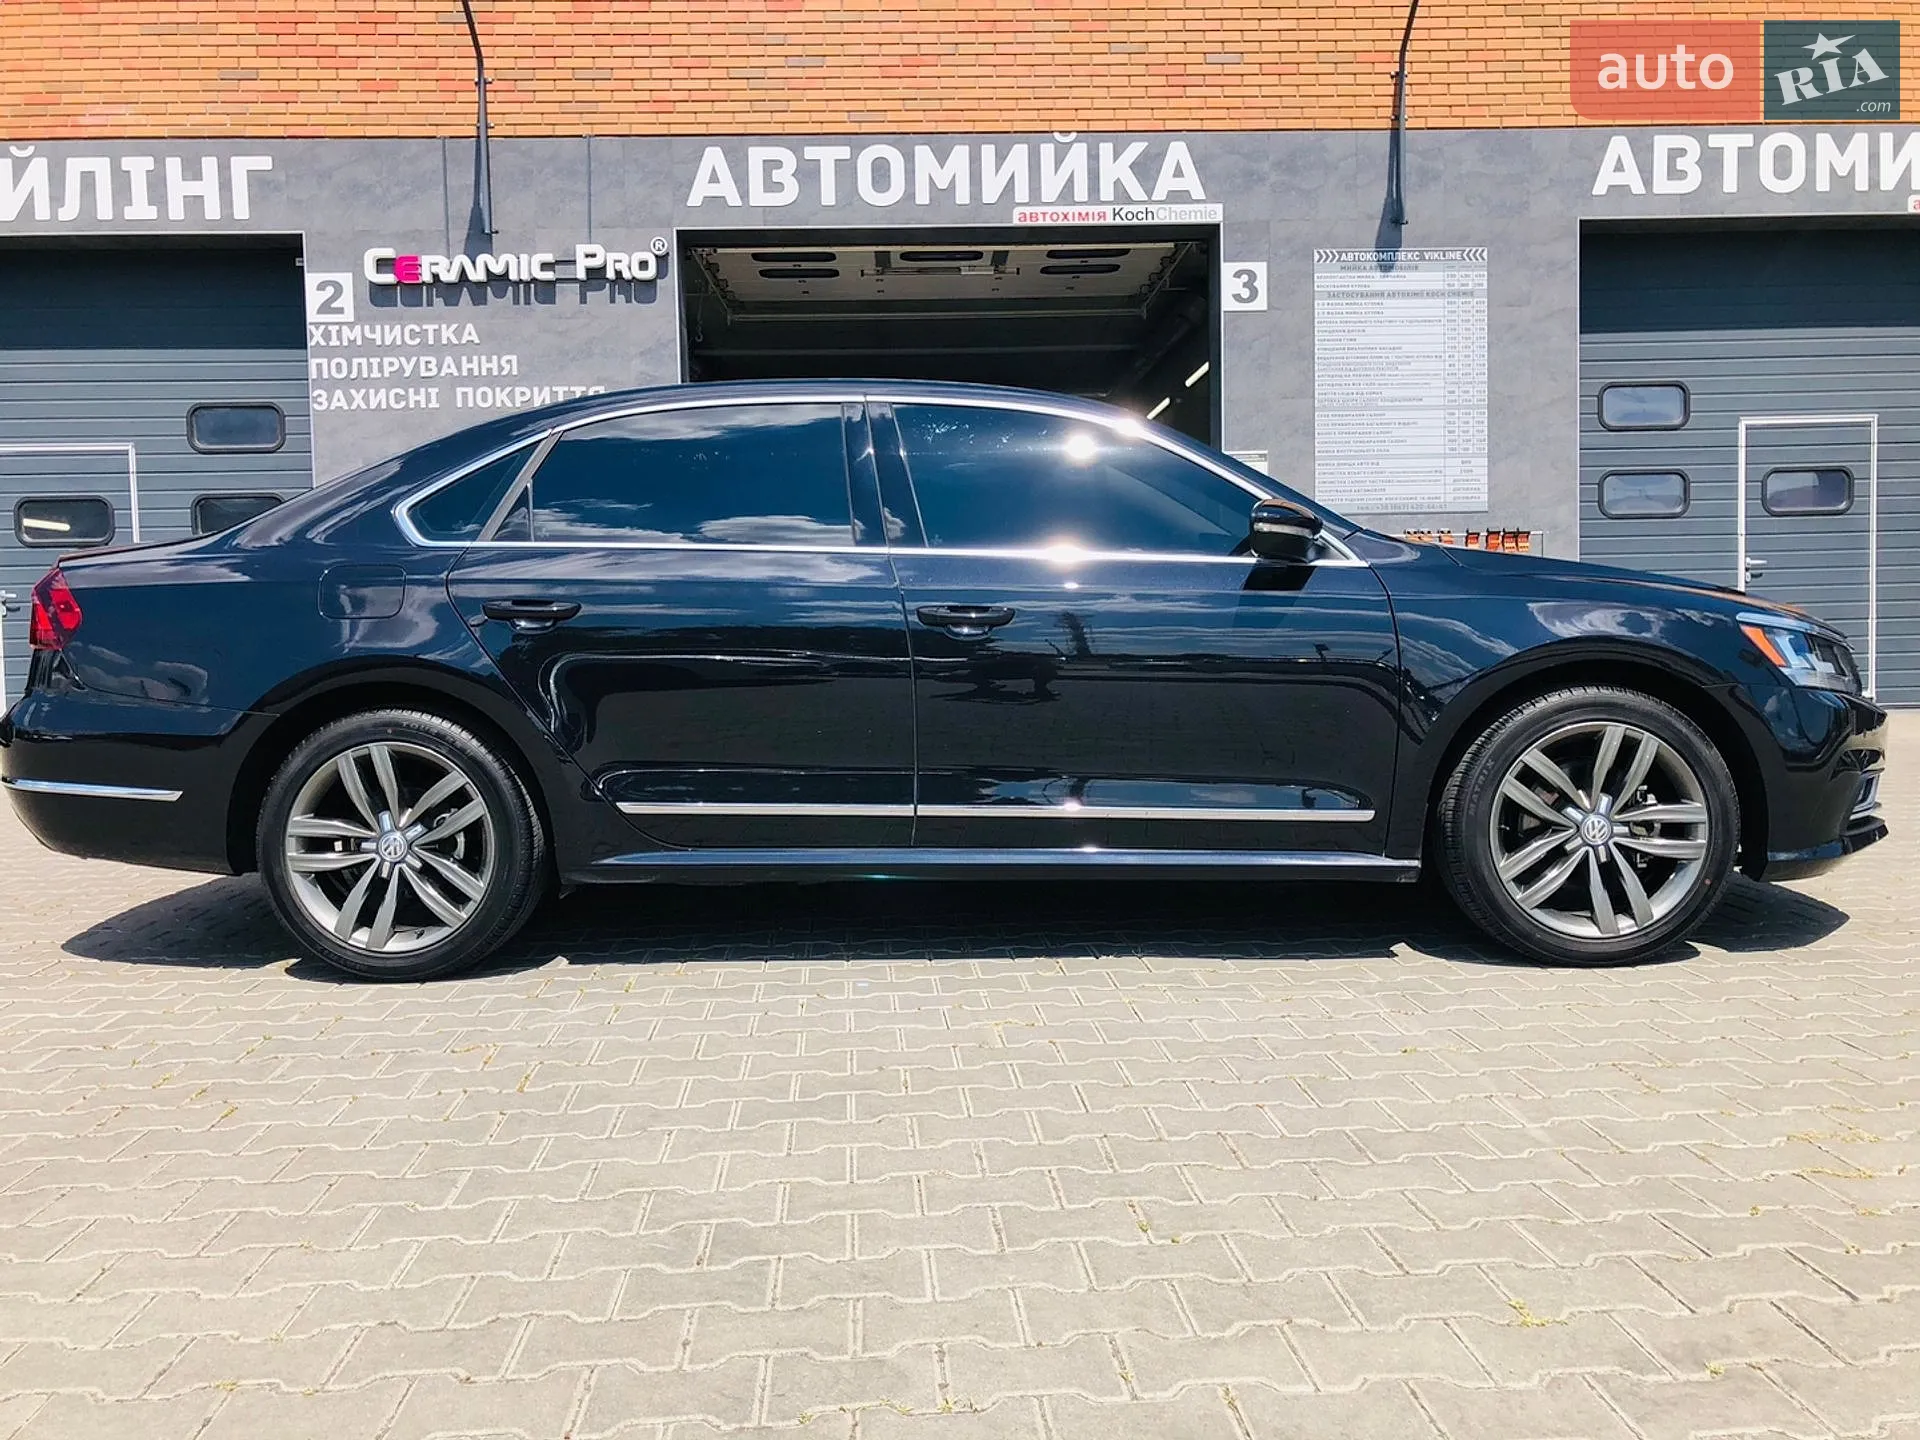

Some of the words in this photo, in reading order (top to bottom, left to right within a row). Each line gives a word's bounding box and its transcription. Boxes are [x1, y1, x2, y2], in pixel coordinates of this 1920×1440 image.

[686, 132, 1206, 207] АВТОМИЙКА
[1591, 131, 1920, 196] АВТОМИ
[0, 145, 273, 221] ЙЛІНГ
[1340, 251, 1421, 262] АВТОКОМПЛЕКС
[1424, 250, 1464, 261] VIKLINE
[315, 280, 345, 315] 2
[1231, 269, 1259, 304] 3
[308, 323, 481, 347] ХІМЧИСТКА
[310, 354, 519, 379] ПОЛІРУВАННЯ
[311, 387, 440, 412] ЗАХИСНІ
